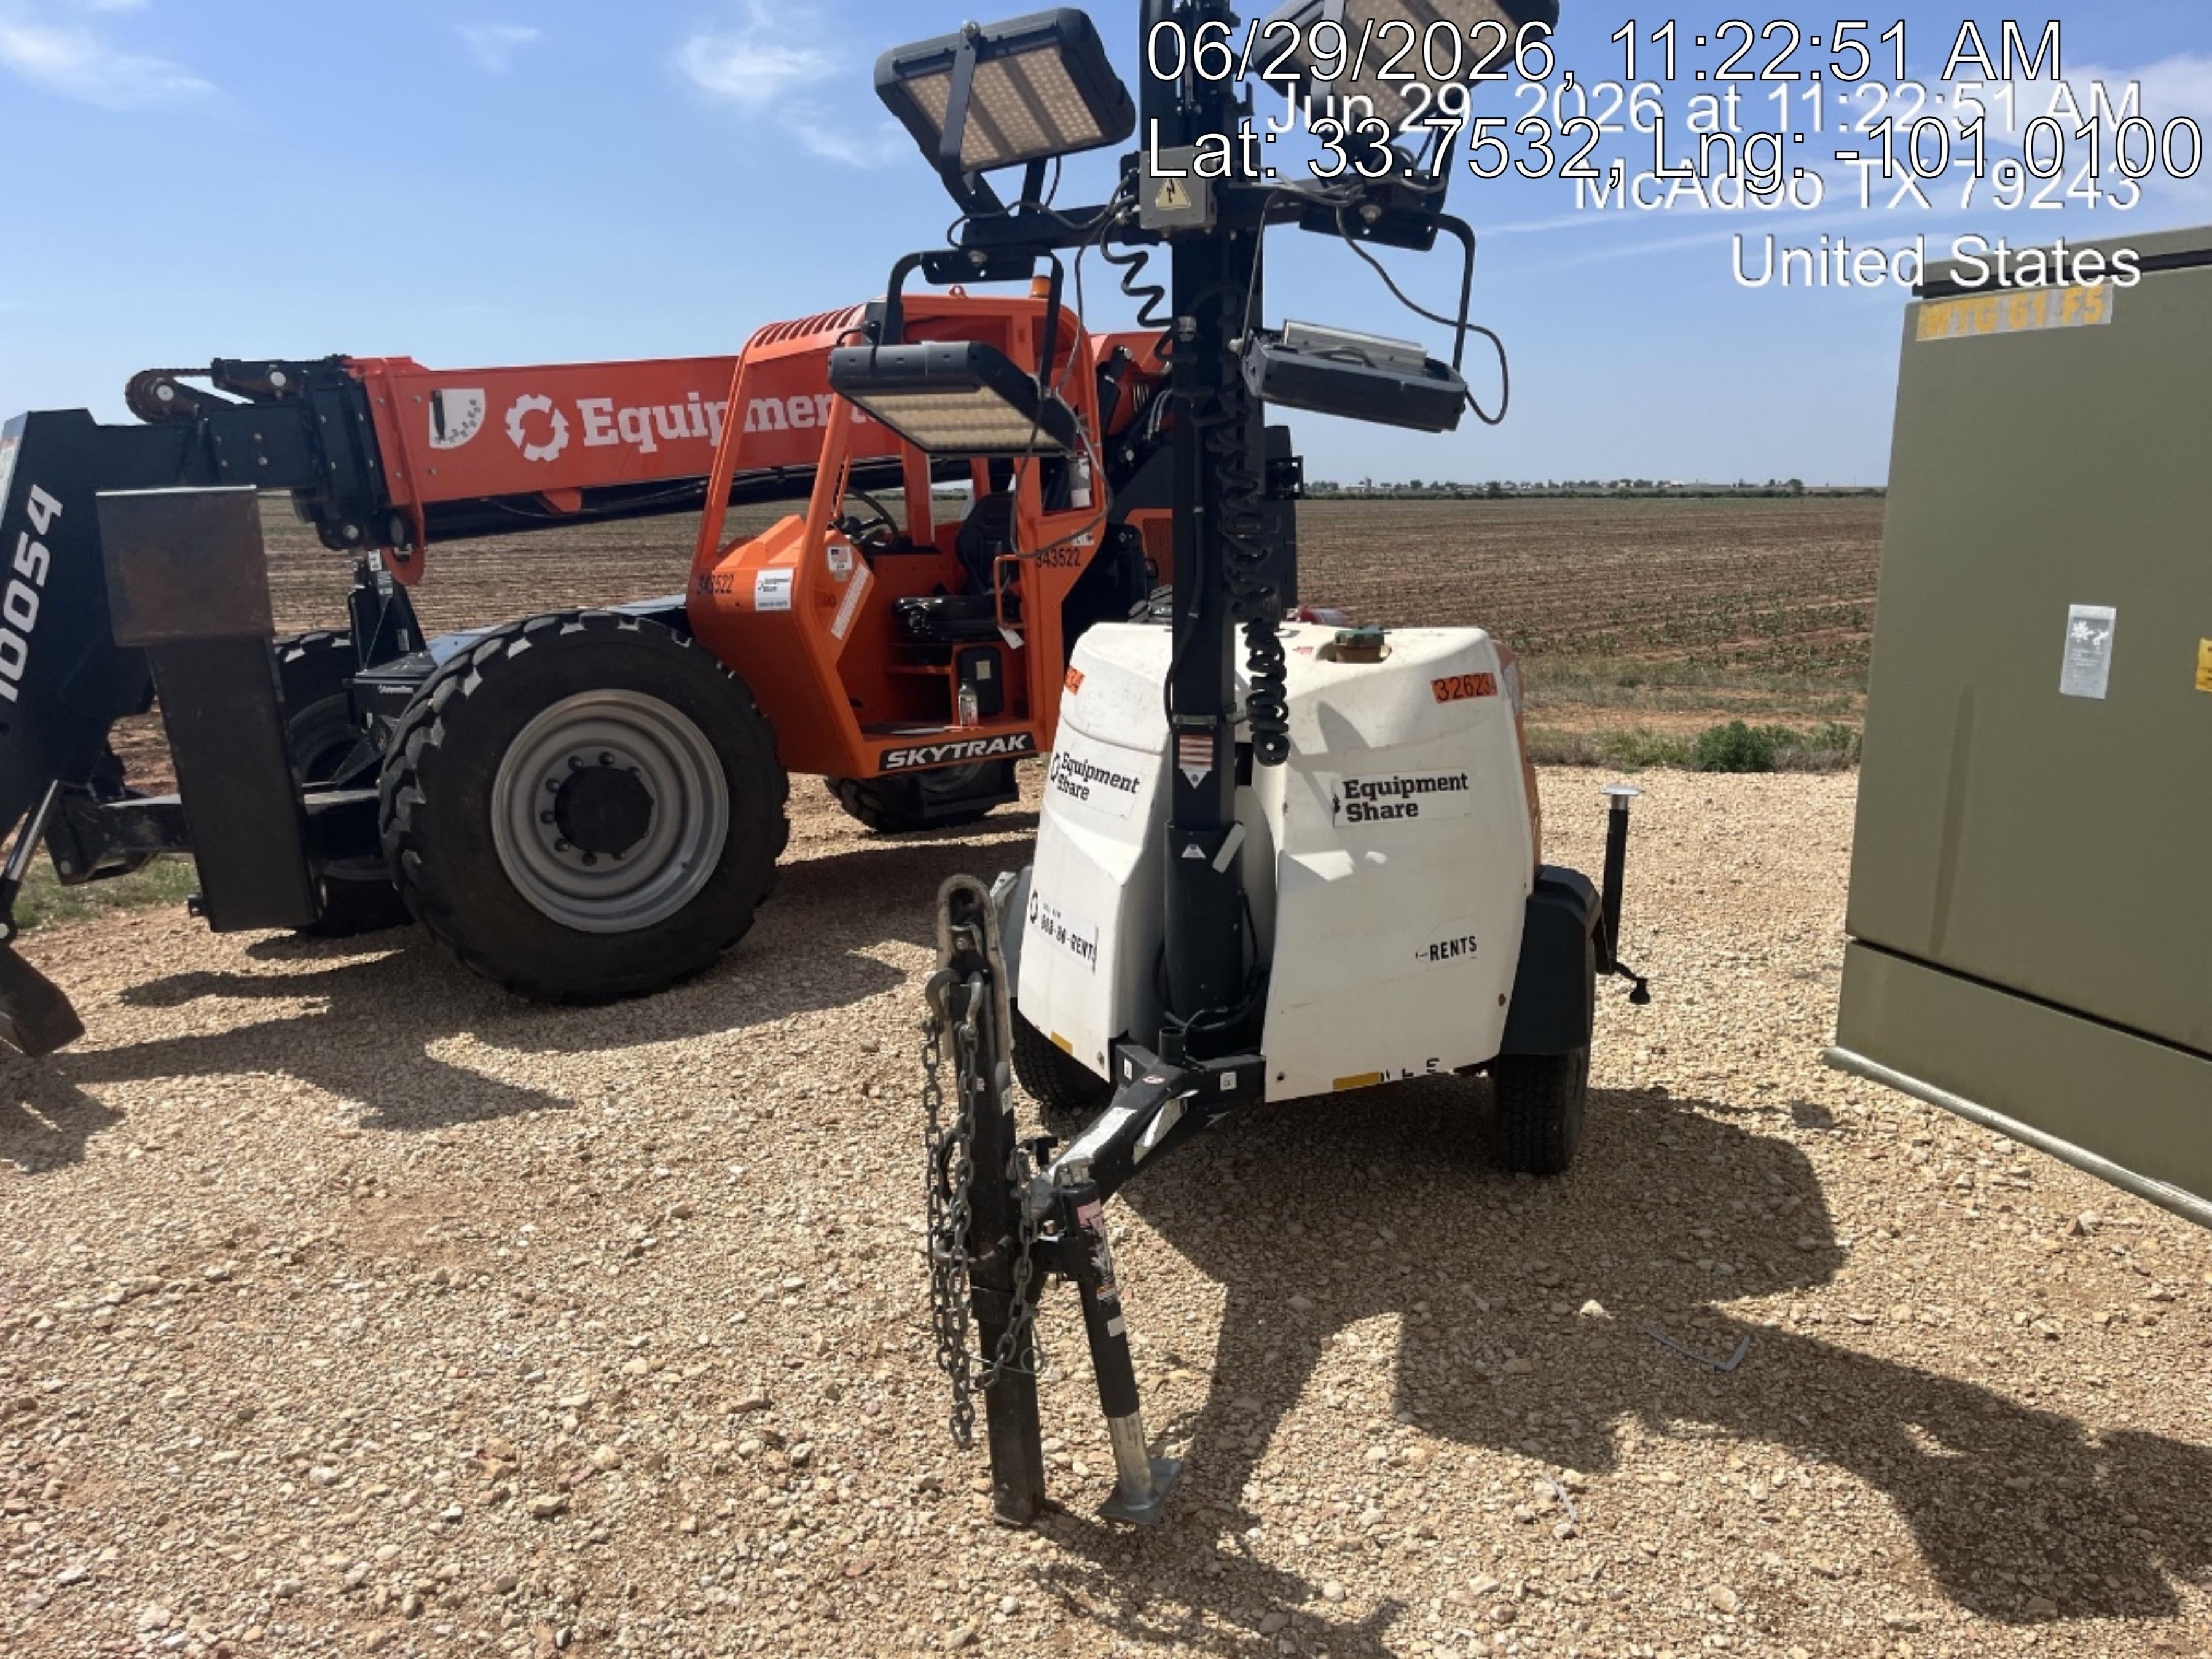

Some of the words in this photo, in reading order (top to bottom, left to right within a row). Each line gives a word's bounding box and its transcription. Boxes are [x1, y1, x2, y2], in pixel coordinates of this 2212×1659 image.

[1035, 547, 1081, 568] 343522
[886, 734, 1027, 769] SKYTRAK
[1062, 751, 1140, 794] Equipment
[1342, 772, 1470, 801] Equipment
[1056, 773, 1090, 801] Share
[1346, 801, 1419, 823] Share
